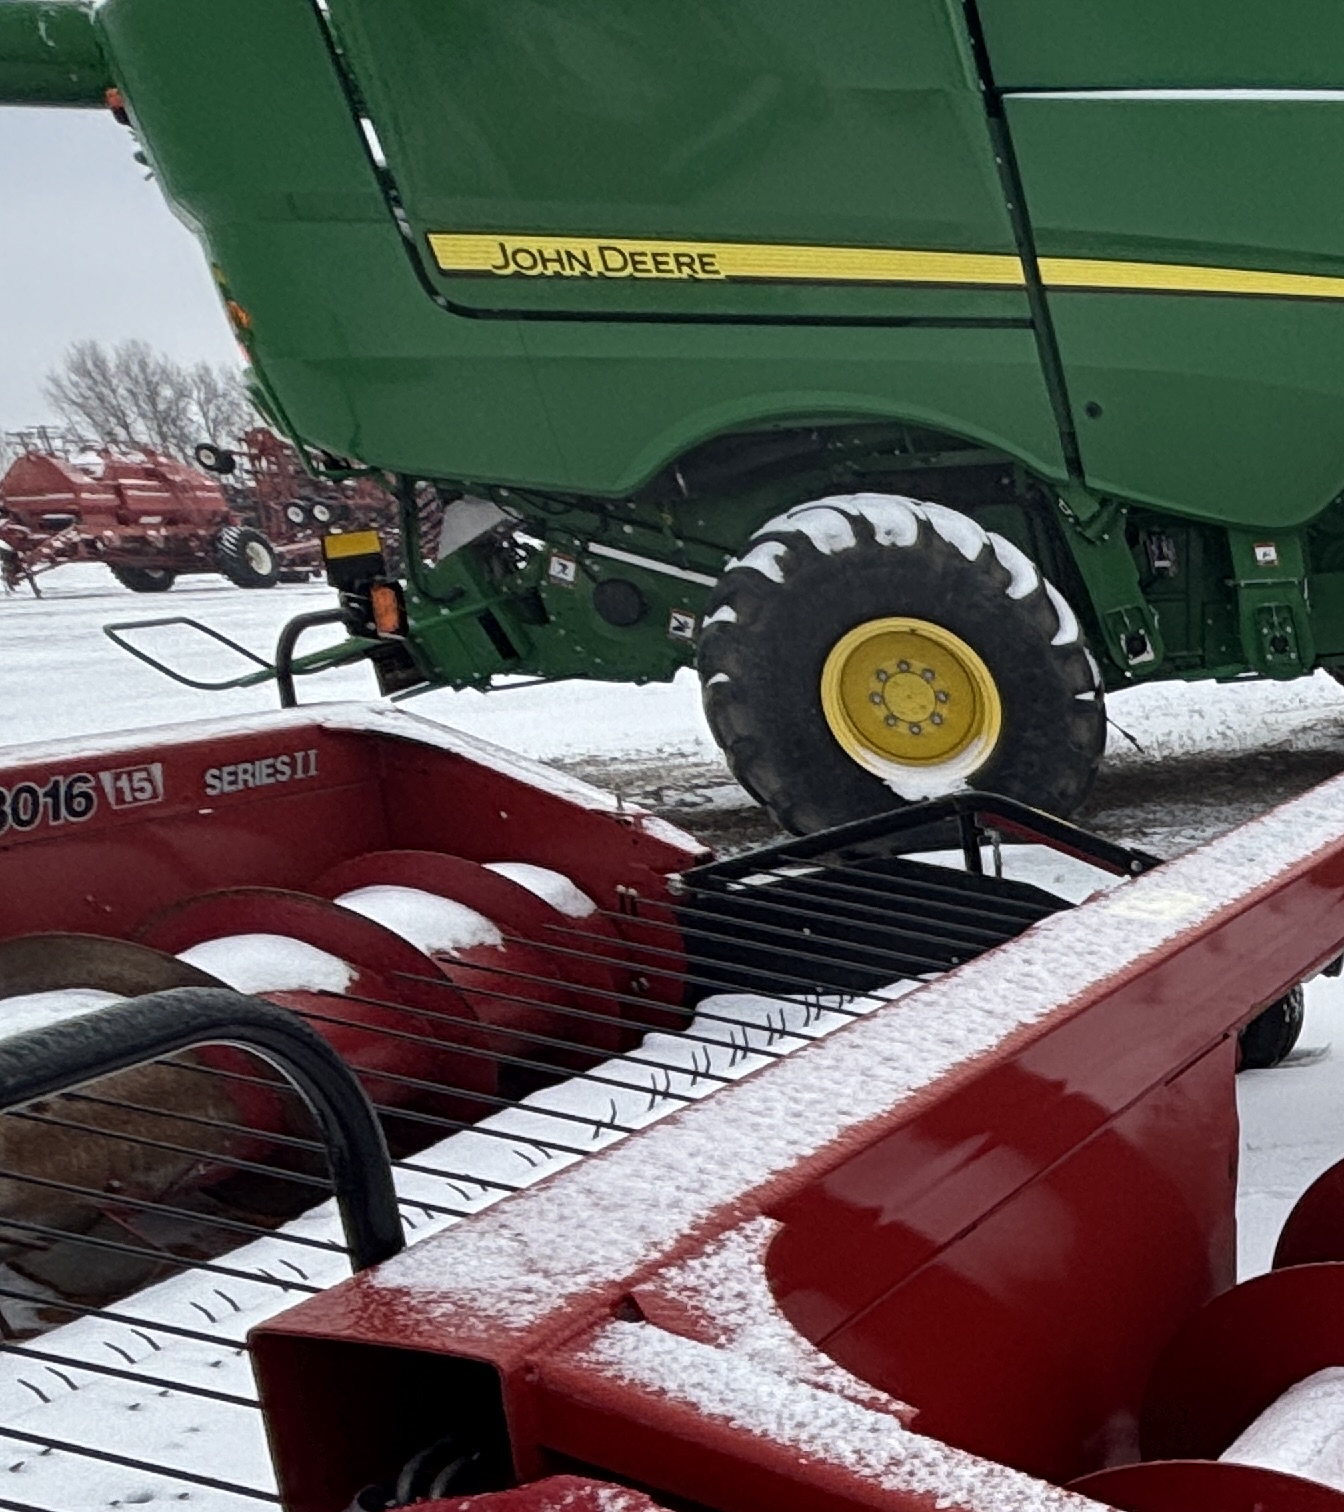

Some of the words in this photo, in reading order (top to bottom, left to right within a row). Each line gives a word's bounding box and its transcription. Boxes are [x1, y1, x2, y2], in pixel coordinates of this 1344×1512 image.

[492, 242, 593, 272] JOHN
[597, 245, 722, 276] DEERE
[115, 771, 152, 803] 15
[204, 755, 292, 797] SERIES
[293, 749, 319, 780] II
